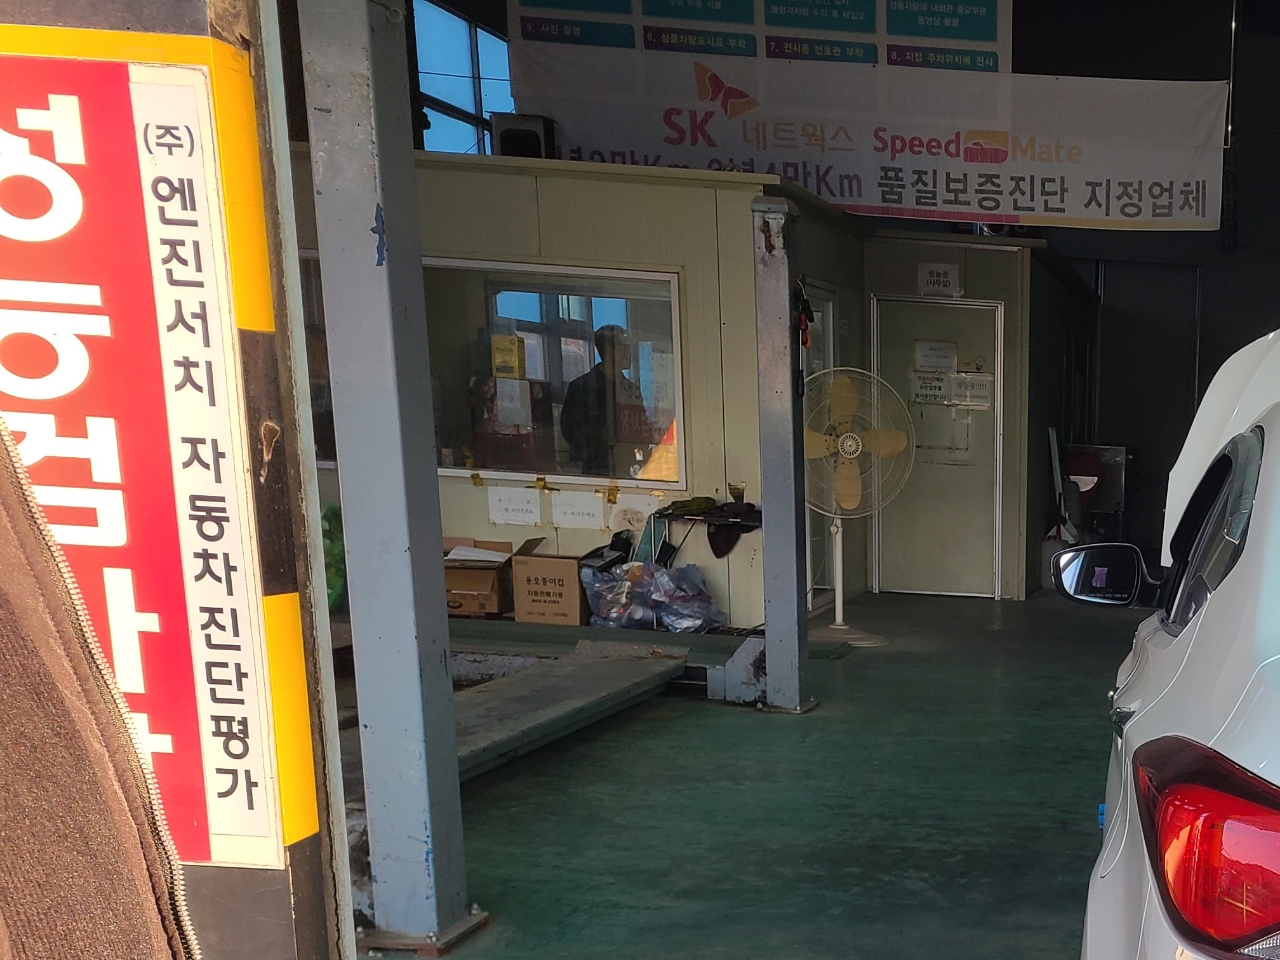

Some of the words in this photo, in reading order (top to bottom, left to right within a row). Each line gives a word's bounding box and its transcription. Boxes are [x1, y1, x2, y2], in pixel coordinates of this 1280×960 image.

[526, 22, 536, 33] 5.
[540, 23, 559, 35] 사진
[646, 32, 656, 42] 6.
[769, 42, 779, 52] 7.
[783, 42, 810, 54] 전시용
[814, 45, 841, 57] 번호판
[905, 51, 923, 62] 지정
[927, 52, 971, 66] 주차위치에
[976, 56, 993, 67] 전시
[662, 107, 718, 148] SK
[742, 119, 856, 153] 네트웍스
[873, 126, 961, 161] Speed
[1011, 136, 1083, 164] Mate
[877, 165, 1069, 214] 품질보증진단
[1083, 177, 1207, 218] 지정업체
[927, 270, 949, 279] 성능장
[180, 436, 260, 811] 자동차진단평가
